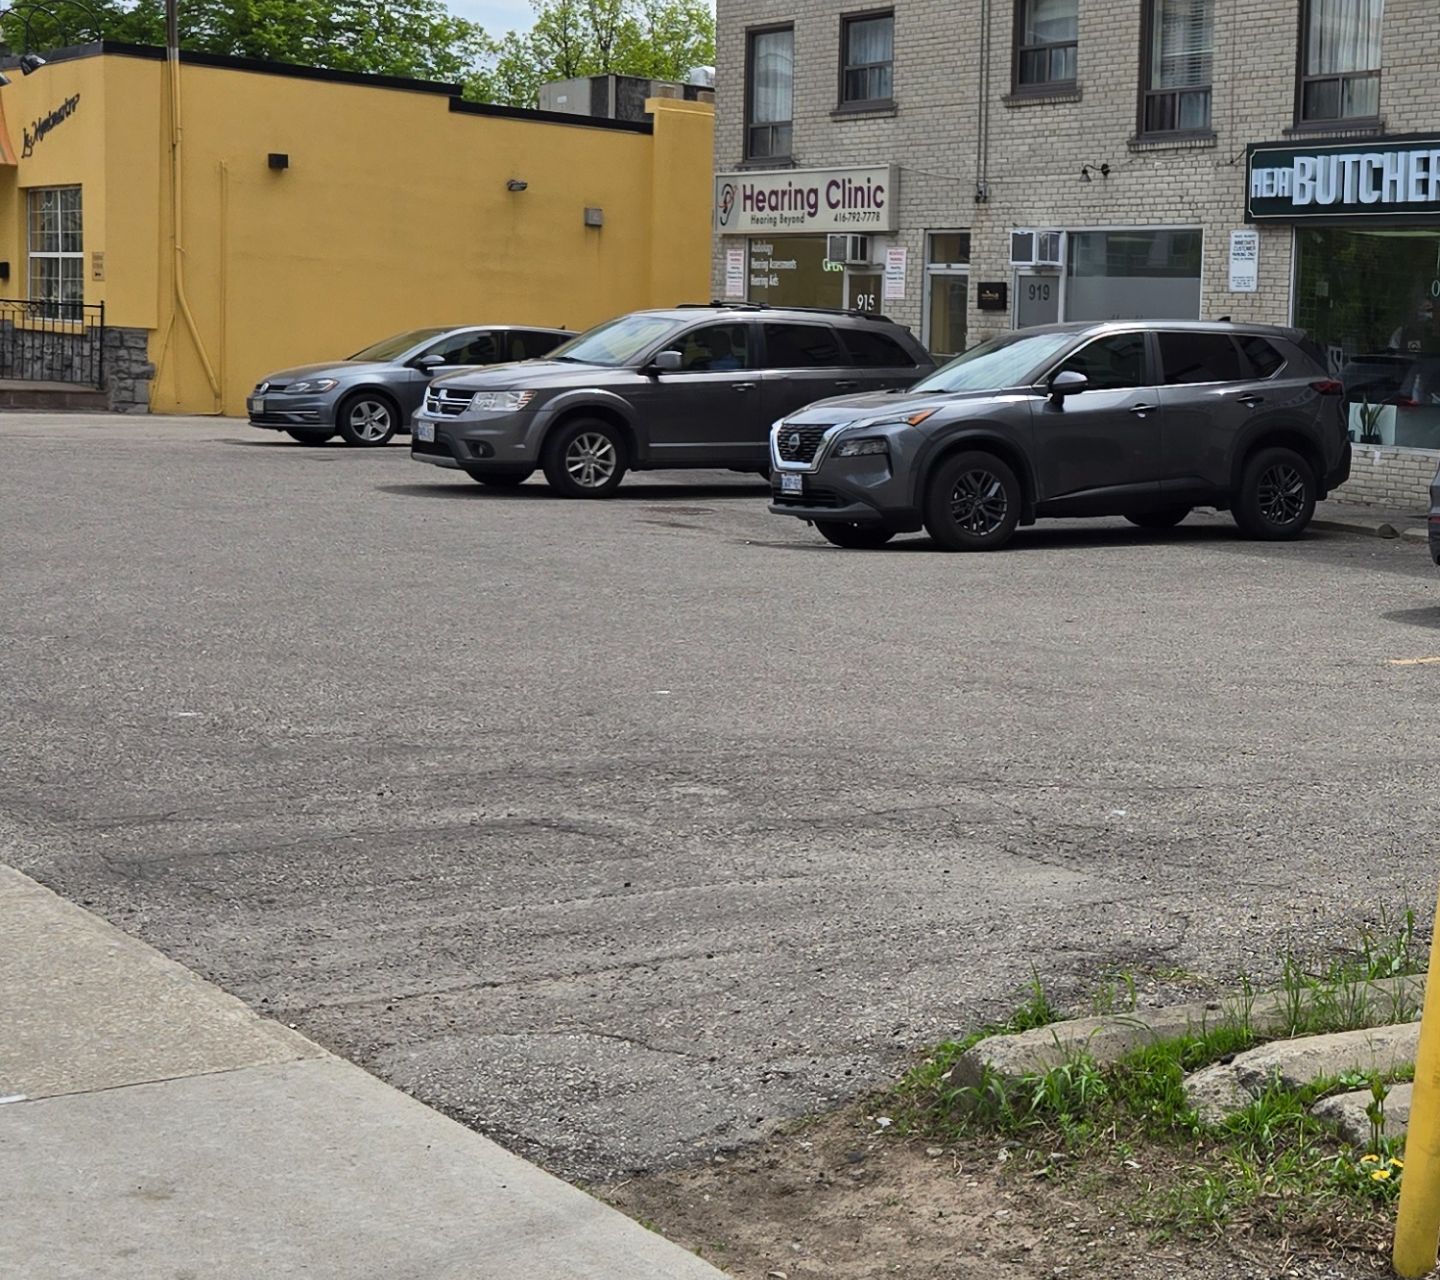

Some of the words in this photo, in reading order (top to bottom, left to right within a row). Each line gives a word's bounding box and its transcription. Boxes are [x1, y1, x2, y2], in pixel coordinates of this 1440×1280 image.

[1251, 168, 1293, 198] HEJA
[743, 181, 818, 217] Hearing
[826, 177, 885, 209] Clinic
[751, 214, 777, 227] Hearing
[780, 213, 805, 225] Beyond
[834, 211, 880, 222] 416-792-7778
[1028, 284, 1050, 301] 919
[857, 294, 875, 311] 915
